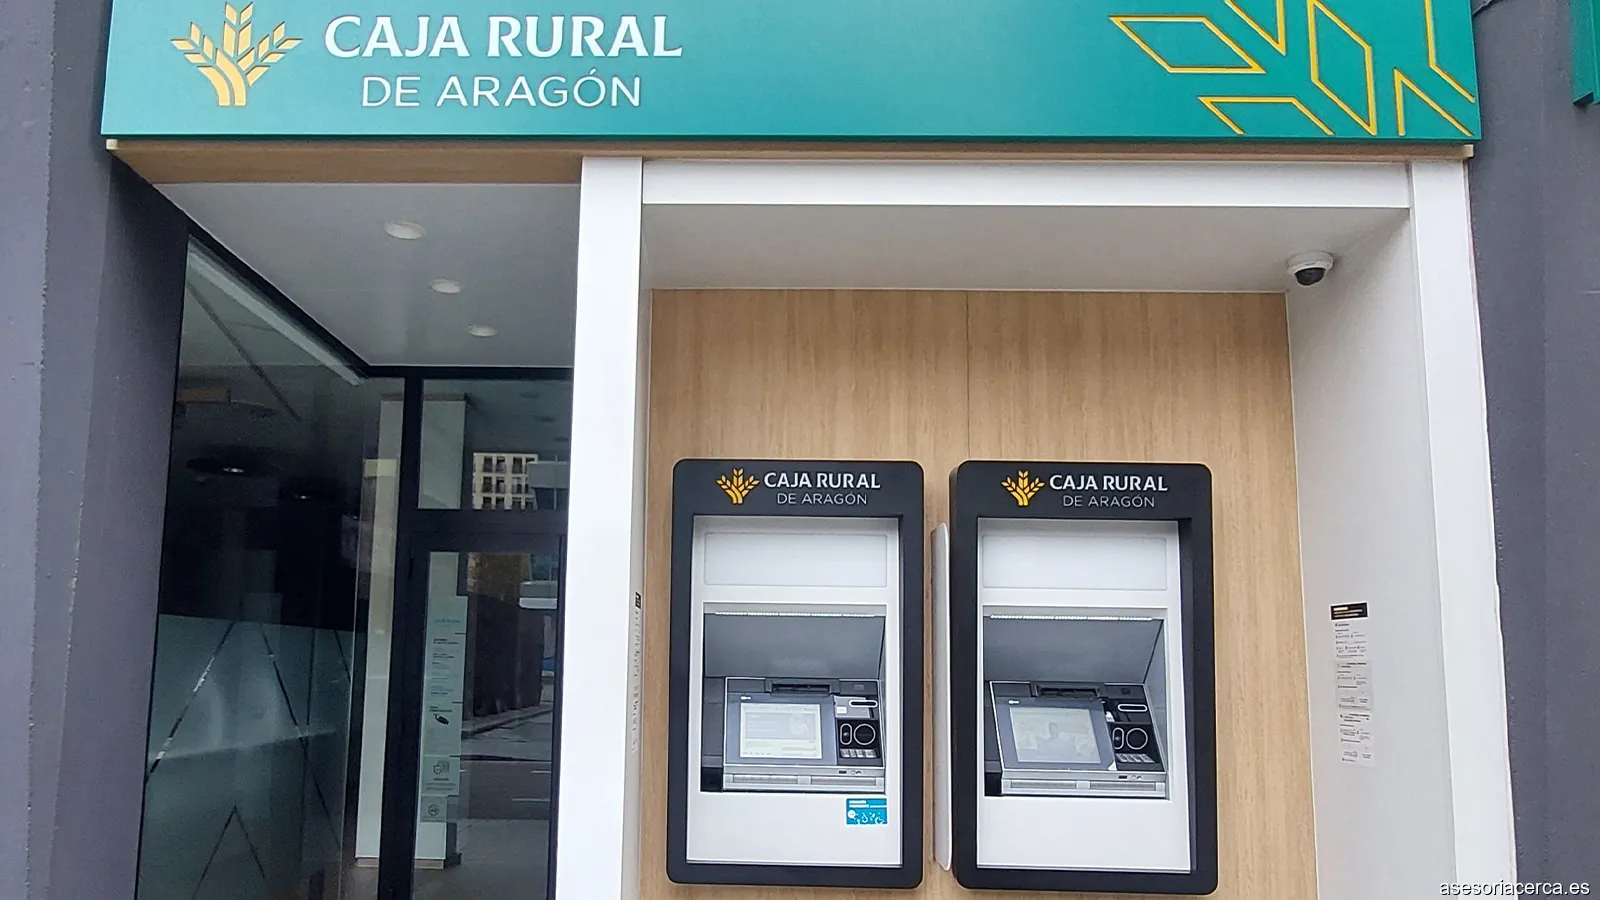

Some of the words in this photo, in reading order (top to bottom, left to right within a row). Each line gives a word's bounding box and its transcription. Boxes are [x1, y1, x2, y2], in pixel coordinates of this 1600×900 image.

[324, 15, 470, 58] CAJA
[487, 15, 683, 58] RURAL
[362, 76, 421, 107] DE
[436, 68, 640, 107] ARAGÓN
[764, 472, 812, 488] CAJA
[816, 472, 881, 489] RURAL
[1049, 474, 1099, 490] CAJA
[1102, 475, 1168, 491] RURAL
[777, 493, 797, 504] DE
[801, 491, 867, 505] ARAGÓN
[1063, 495, 1083, 507] DE
[1087, 494, 1155, 508] ARAGÓN
